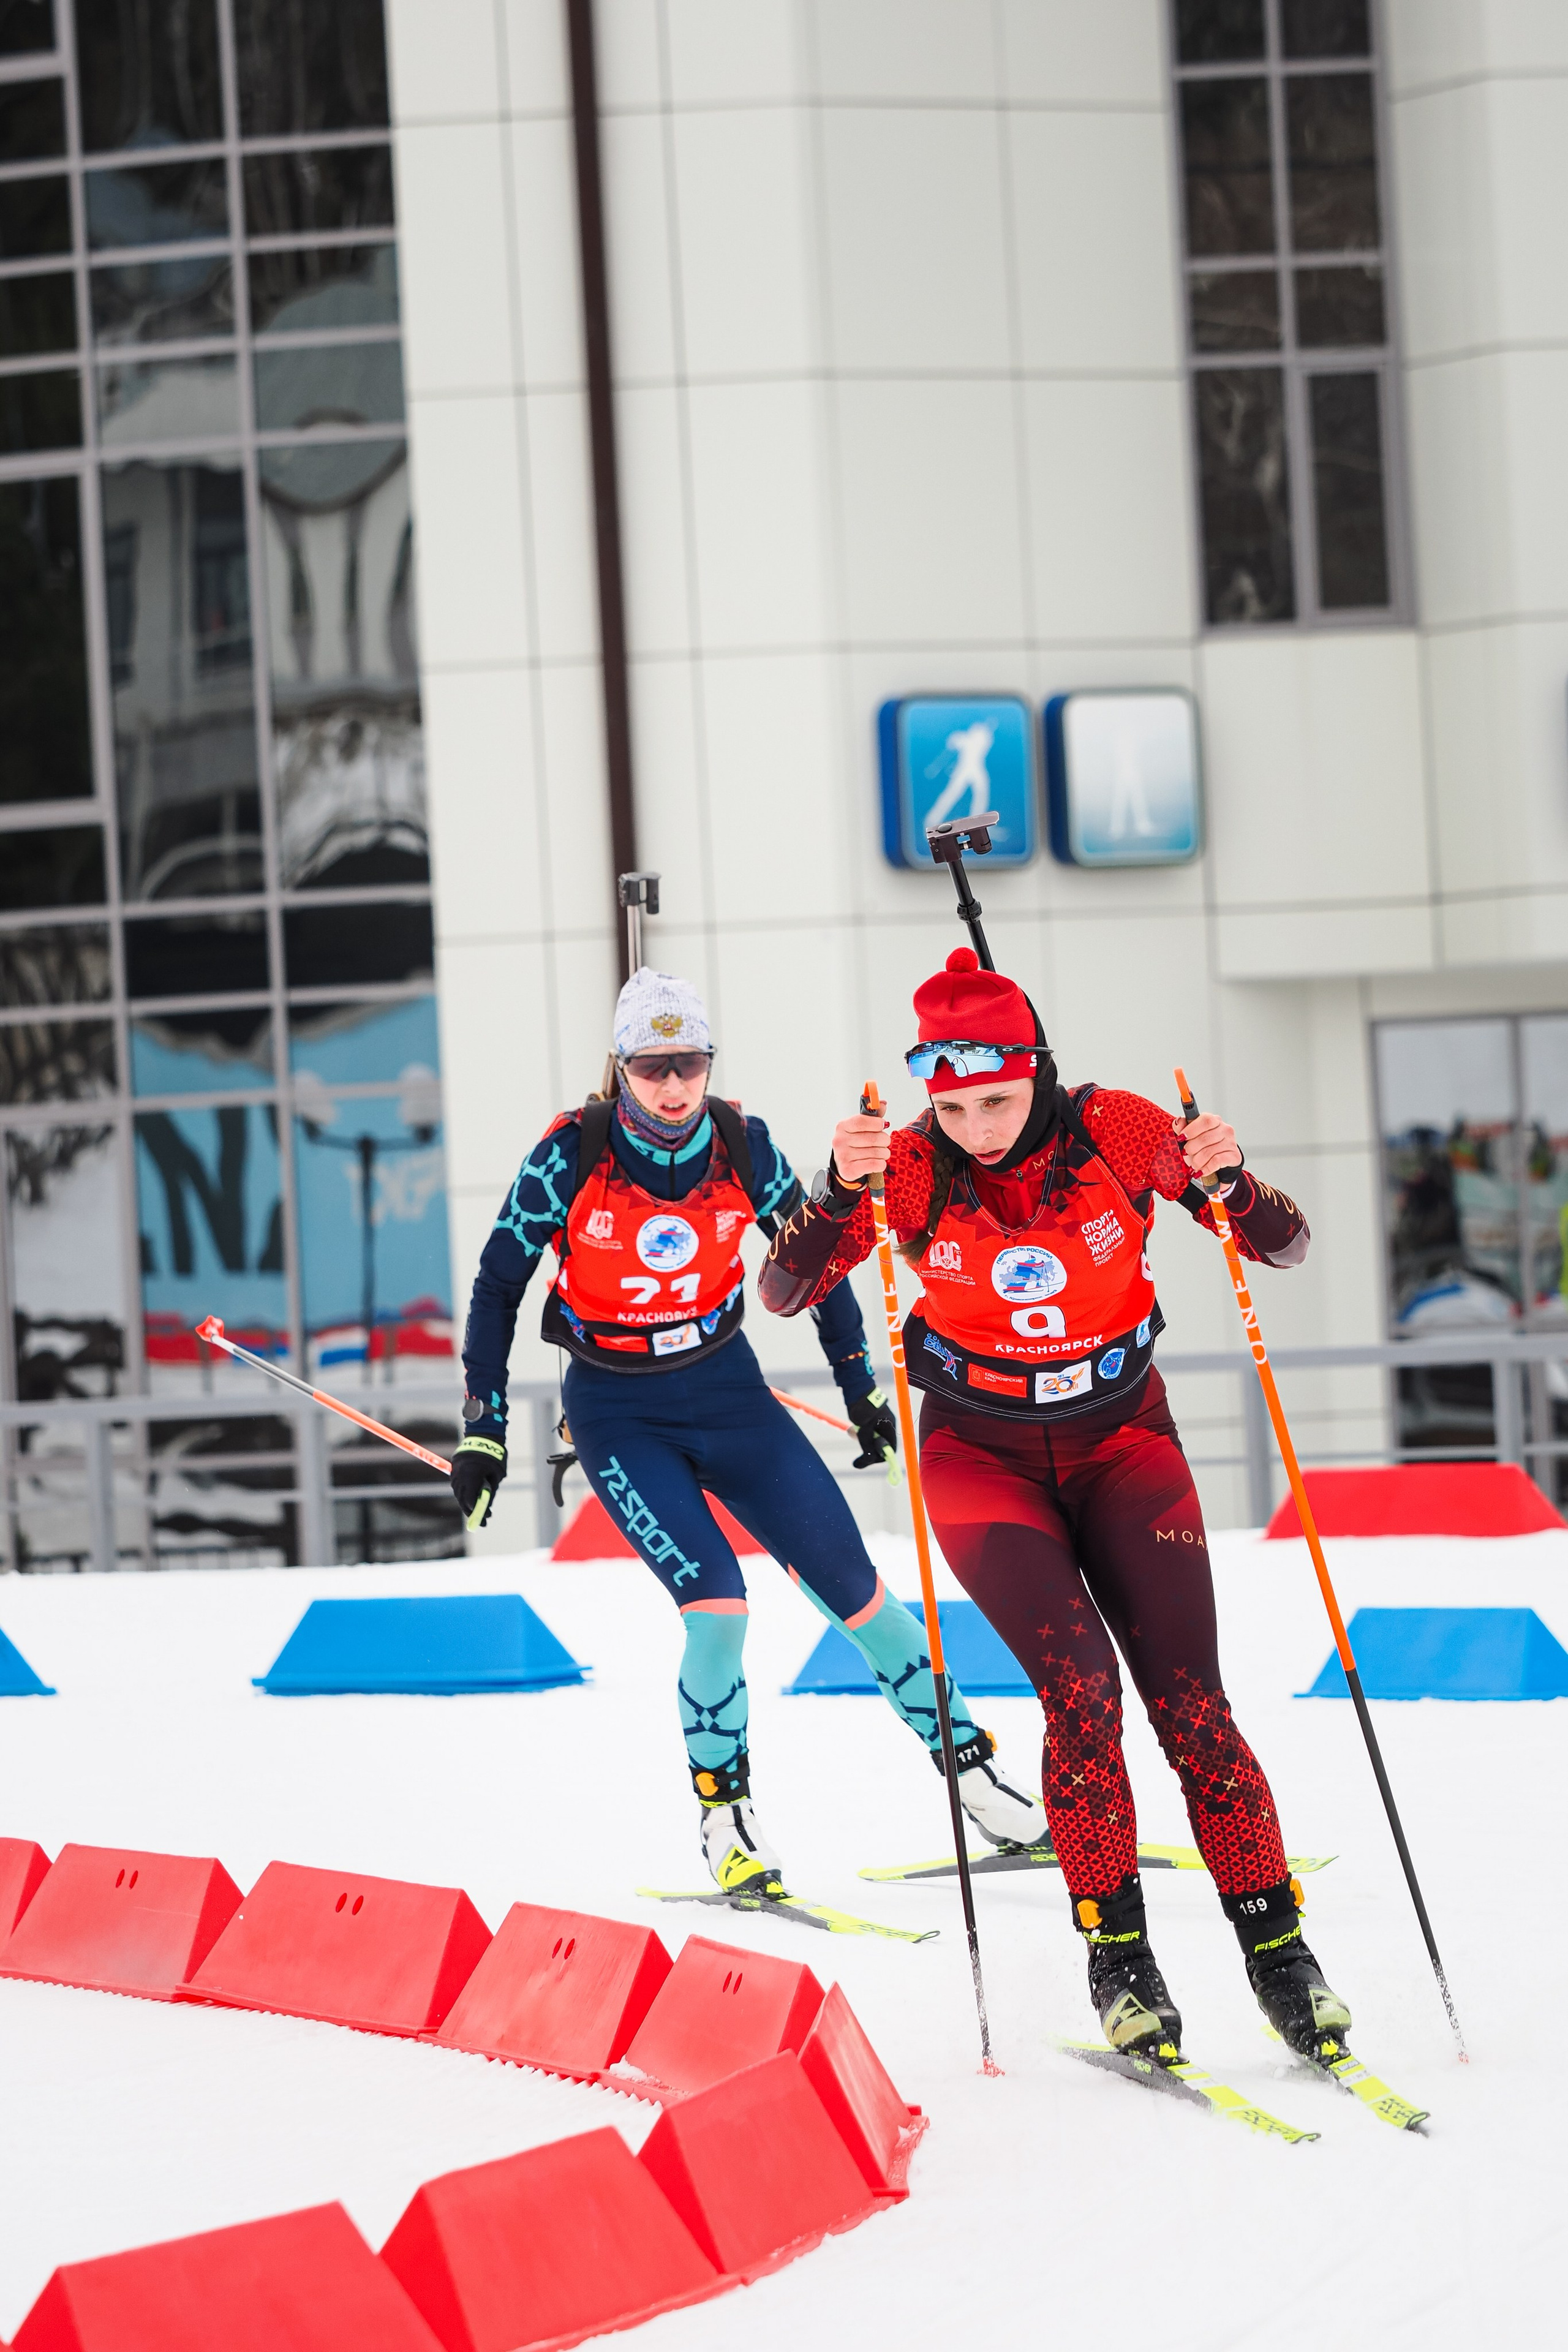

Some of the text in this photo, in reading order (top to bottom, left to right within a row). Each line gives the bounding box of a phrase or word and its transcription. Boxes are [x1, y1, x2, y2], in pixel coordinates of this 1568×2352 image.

[1081, 1212, 1110, 1234] СПОРТ
[1085, 1216, 1120, 1246] НОРМА
[1089, 1226, 1125, 1256] ЖИЗНИ
[1027, 1248, 1054, 1259] РОССИИ
[1095, 1253, 1114, 1267] ПРОЕКТ
[949, 1277, 976, 1286] ФЕДЕРАЦИИ
[995, 1334, 1104, 1355] КРАСНОЯРСК
[984, 1372, 1023, 1383] КРАСНОЯРСКИЙ
[957, 1744, 980, 1763] 171
[1239, 1898, 1268, 1915] 159
